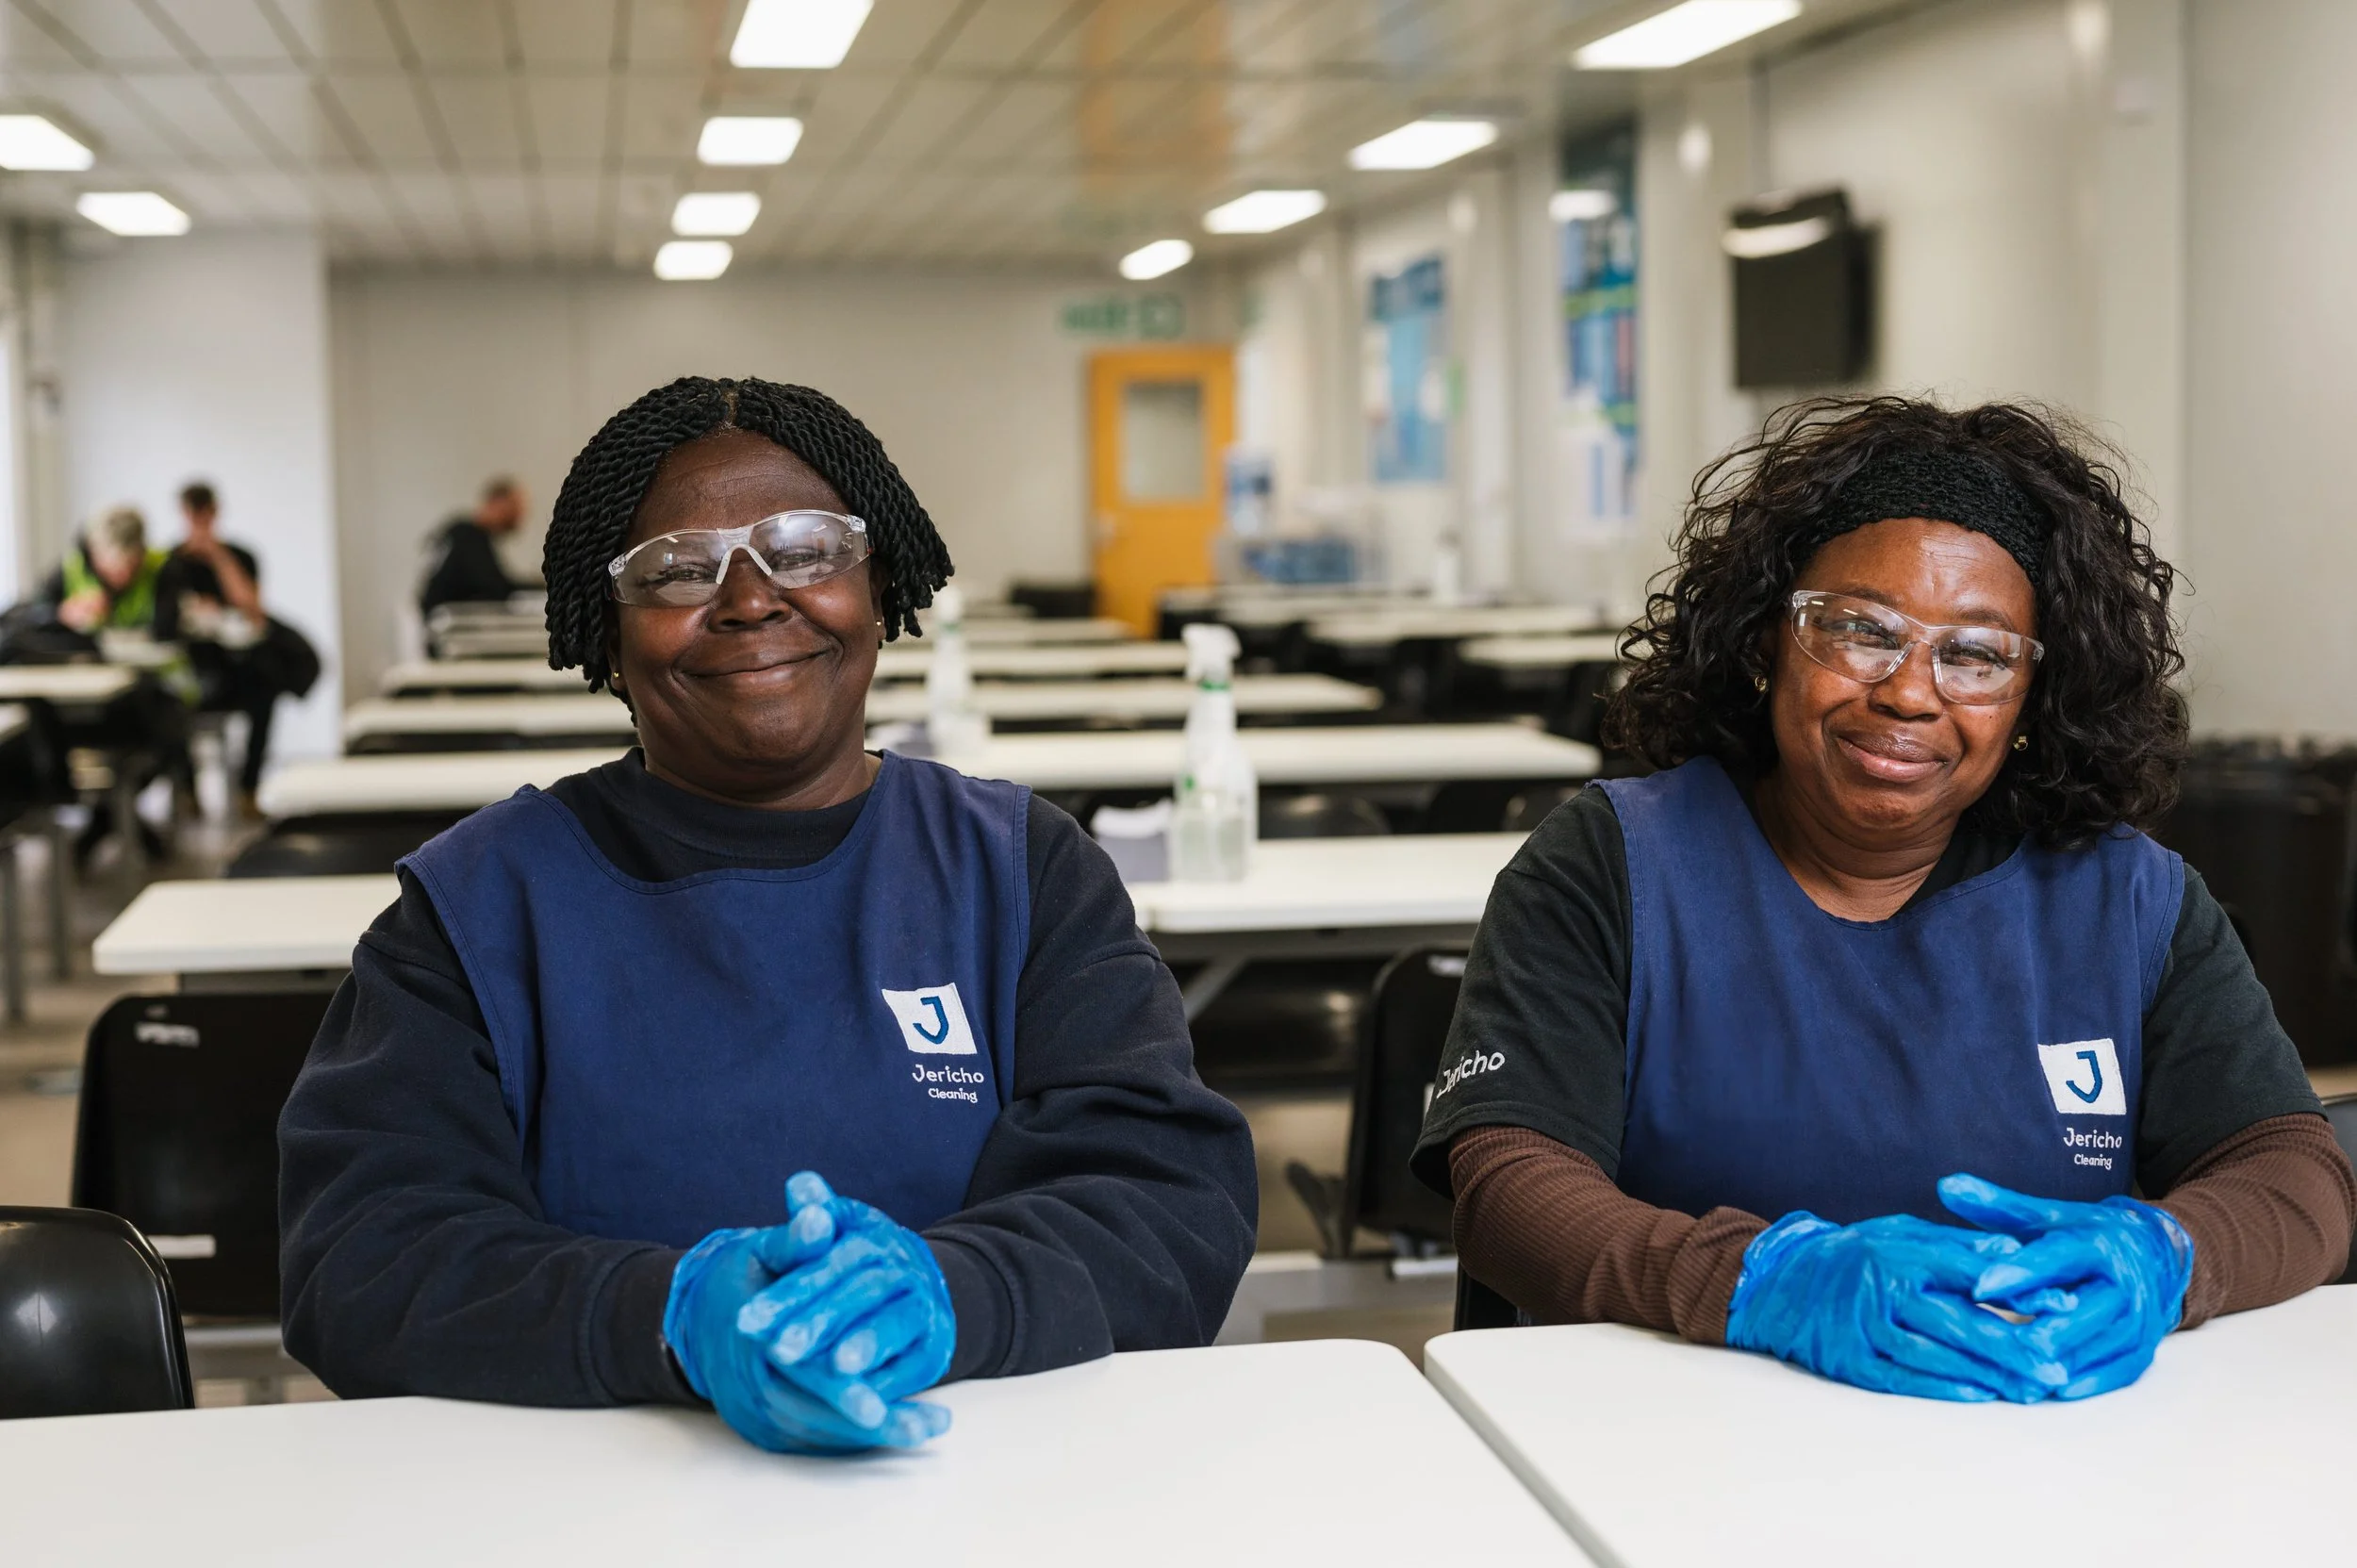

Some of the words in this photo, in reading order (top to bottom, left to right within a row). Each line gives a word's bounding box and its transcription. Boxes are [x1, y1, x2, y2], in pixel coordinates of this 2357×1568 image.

[913, 996, 949, 1045] J
[912, 1064, 984, 1083] Jericho
[2066, 1050, 2103, 1104] J
[928, 1087, 978, 1104] Cleaning
[2063, 1127, 2122, 1148] Jericho
[2074, 1153, 2112, 1170] Cleaning
